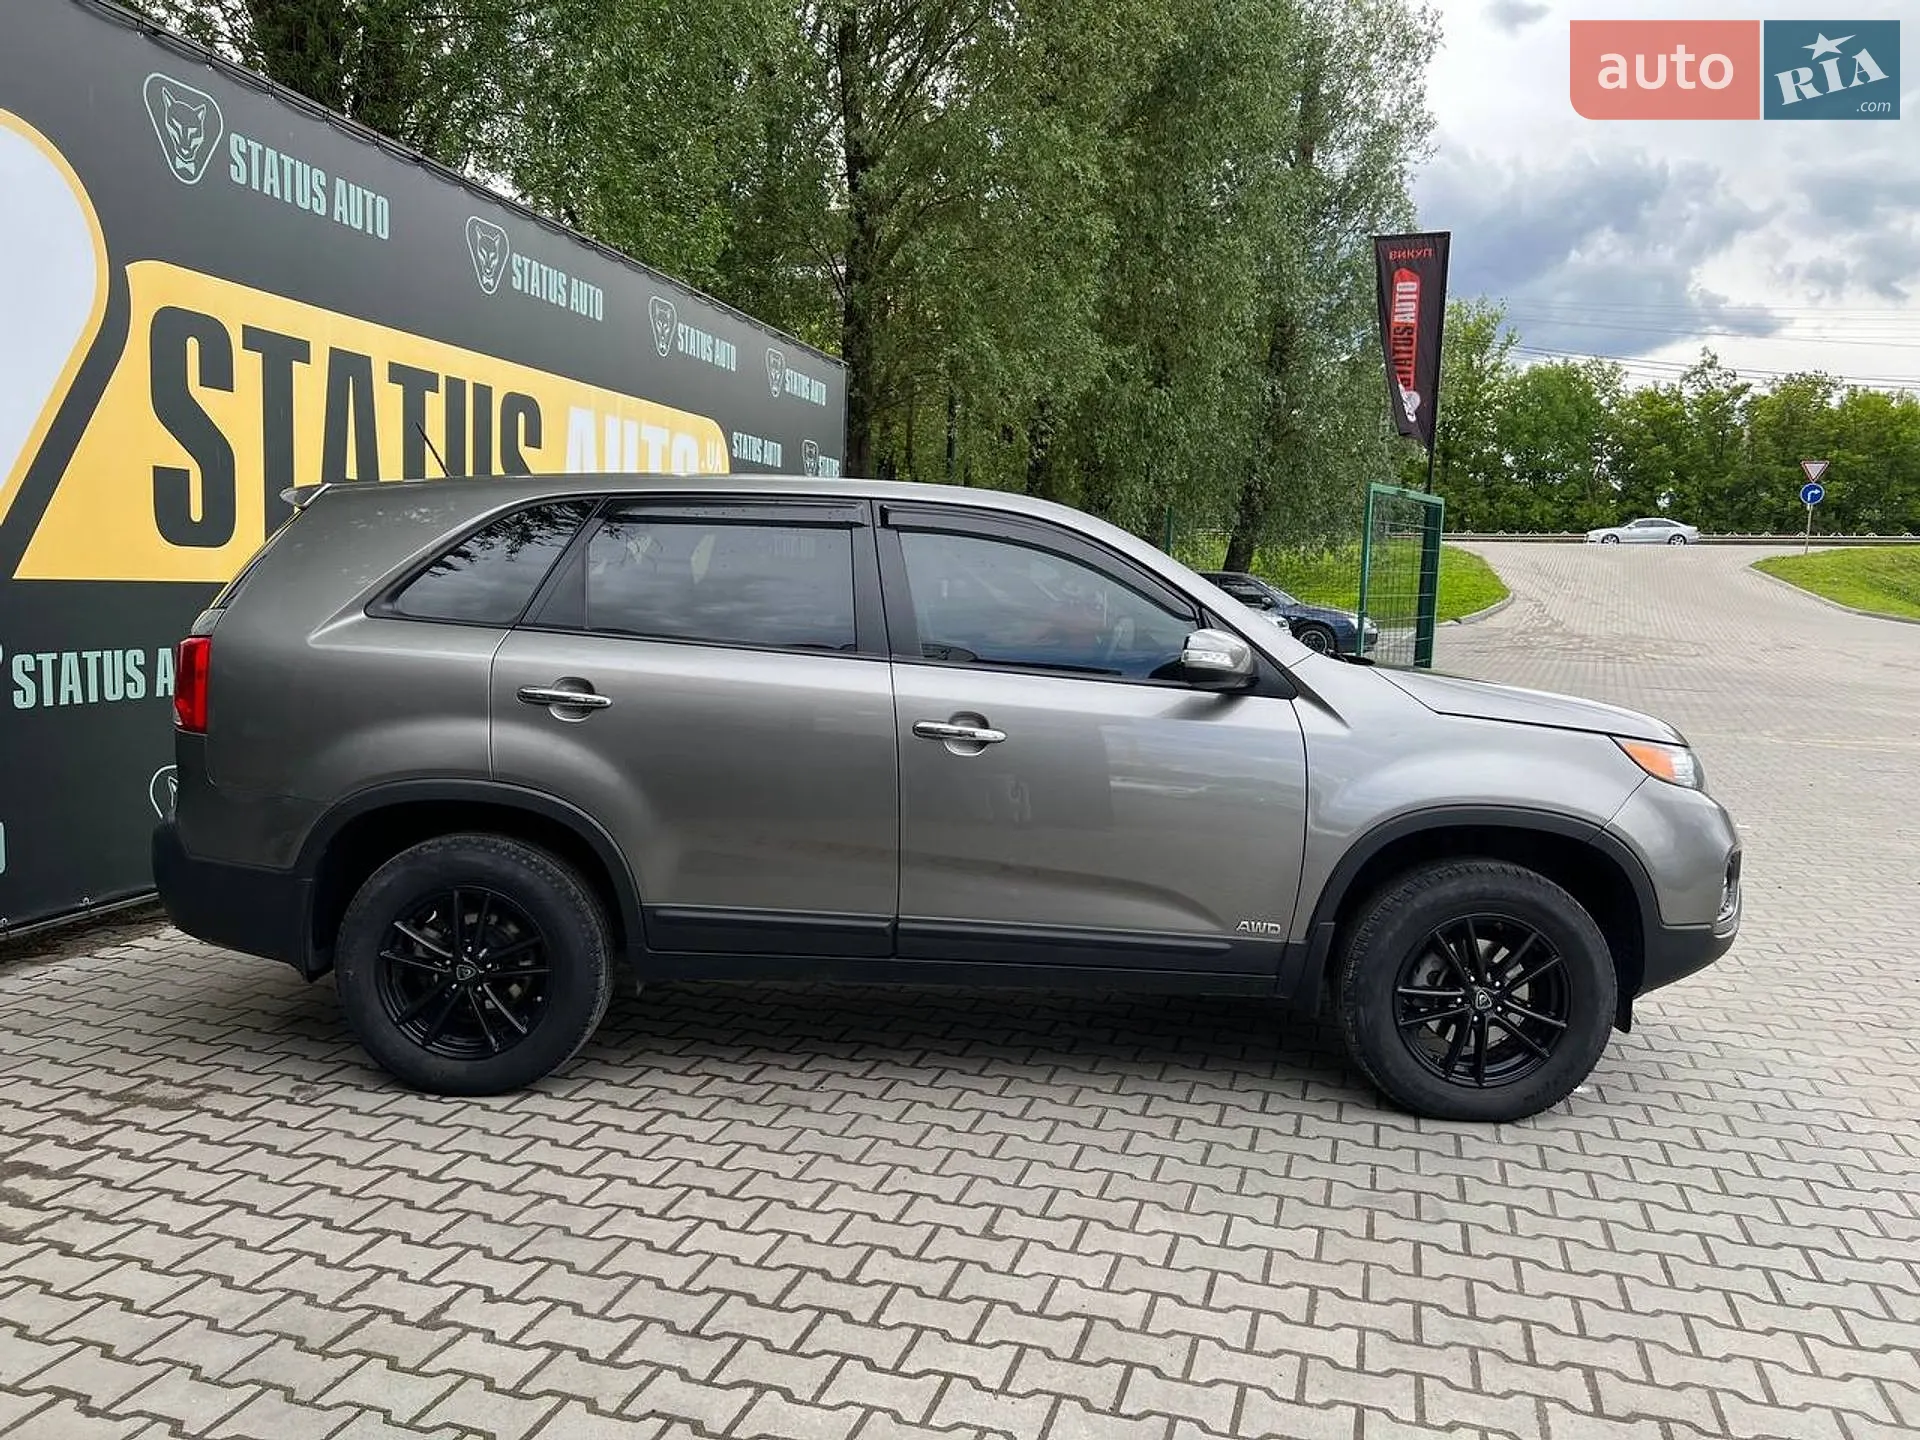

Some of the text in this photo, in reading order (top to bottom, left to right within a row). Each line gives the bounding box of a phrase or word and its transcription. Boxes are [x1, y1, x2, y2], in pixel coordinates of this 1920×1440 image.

[229, 132, 390, 240] STATUS AUTO
[1389, 247, 1434, 260] ВИКУП
[511, 252, 604, 321] STATUS AUTO
[1394, 282, 1418, 323] AUTO
[677, 322, 737, 372] STATUS AUTO
[149, 305, 543, 549] STATUS
[732, 431, 762, 463] STATUS
[12, 649, 147, 709] STATUS
[1236, 920, 1281, 934] AWD
